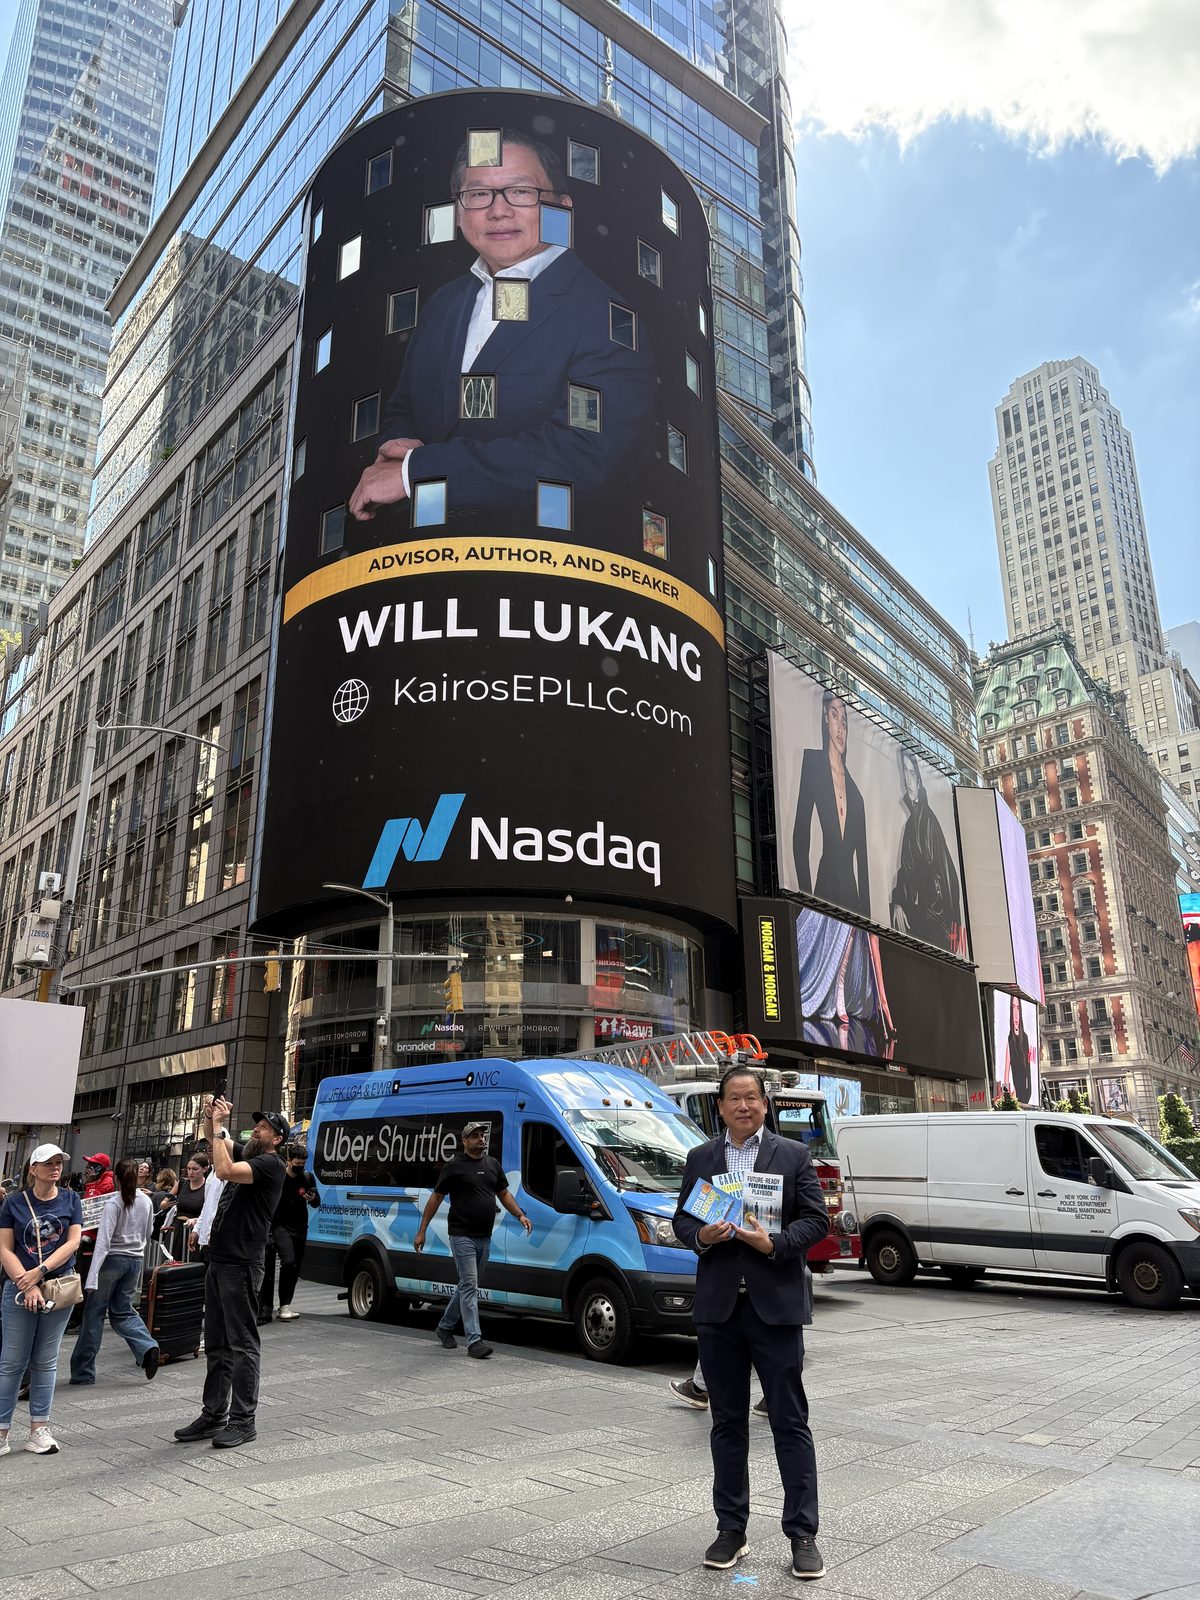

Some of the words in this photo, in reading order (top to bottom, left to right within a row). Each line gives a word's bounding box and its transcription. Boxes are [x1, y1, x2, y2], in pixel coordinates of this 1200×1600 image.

[368, 547, 460, 573] ADVISOR,
[465, 547, 558, 569] AUTHOR,
[562, 553, 606, 573] AND
[610, 563, 680, 601] SPEAKER
[338, 597, 479, 654] WILL
[499, 597, 702, 682] LUKANG
[393, 672, 693, 737] KairosEPLLC.com
[470, 816, 662, 888] Nasdaq
[761, 921, 775, 962] MORGAN
[763, 964, 775, 972] &
[764, 974, 778, 1017] MORGAN
[334, 1030, 367, 1040] TOMORROW
[434, 1023, 464, 1033] Nasdaq
[478, 1024, 512, 1032] REWRITE
[517, 1024, 560, 1033] TOMORROW
[474, 1070, 501, 1087] NYC
[363, 1084, 370, 1097] &
[371, 1081, 392, 1096] EWR
[323, 1126, 374, 1162] Uber
[376, 1123, 457, 1163] Shuttle
[320, 1168, 339, 1178] Powered
[339, 1169, 344, 1179] by
[344, 1169, 353, 1178] ETS
[747, 1176, 781, 1185] FUTURE-READY
[748, 1183, 778, 1192] PERFORMANCE
[752, 1189, 773, 1197] PLAYBOOK
[318, 1203, 349, 1216] Affordable
[350, 1206, 371, 1218] airport
[371, 1206, 387, 1218] rides
[1079, 1207, 1112, 1215] MAINTENANCE
[432, 1283, 455, 1296] PLATE
